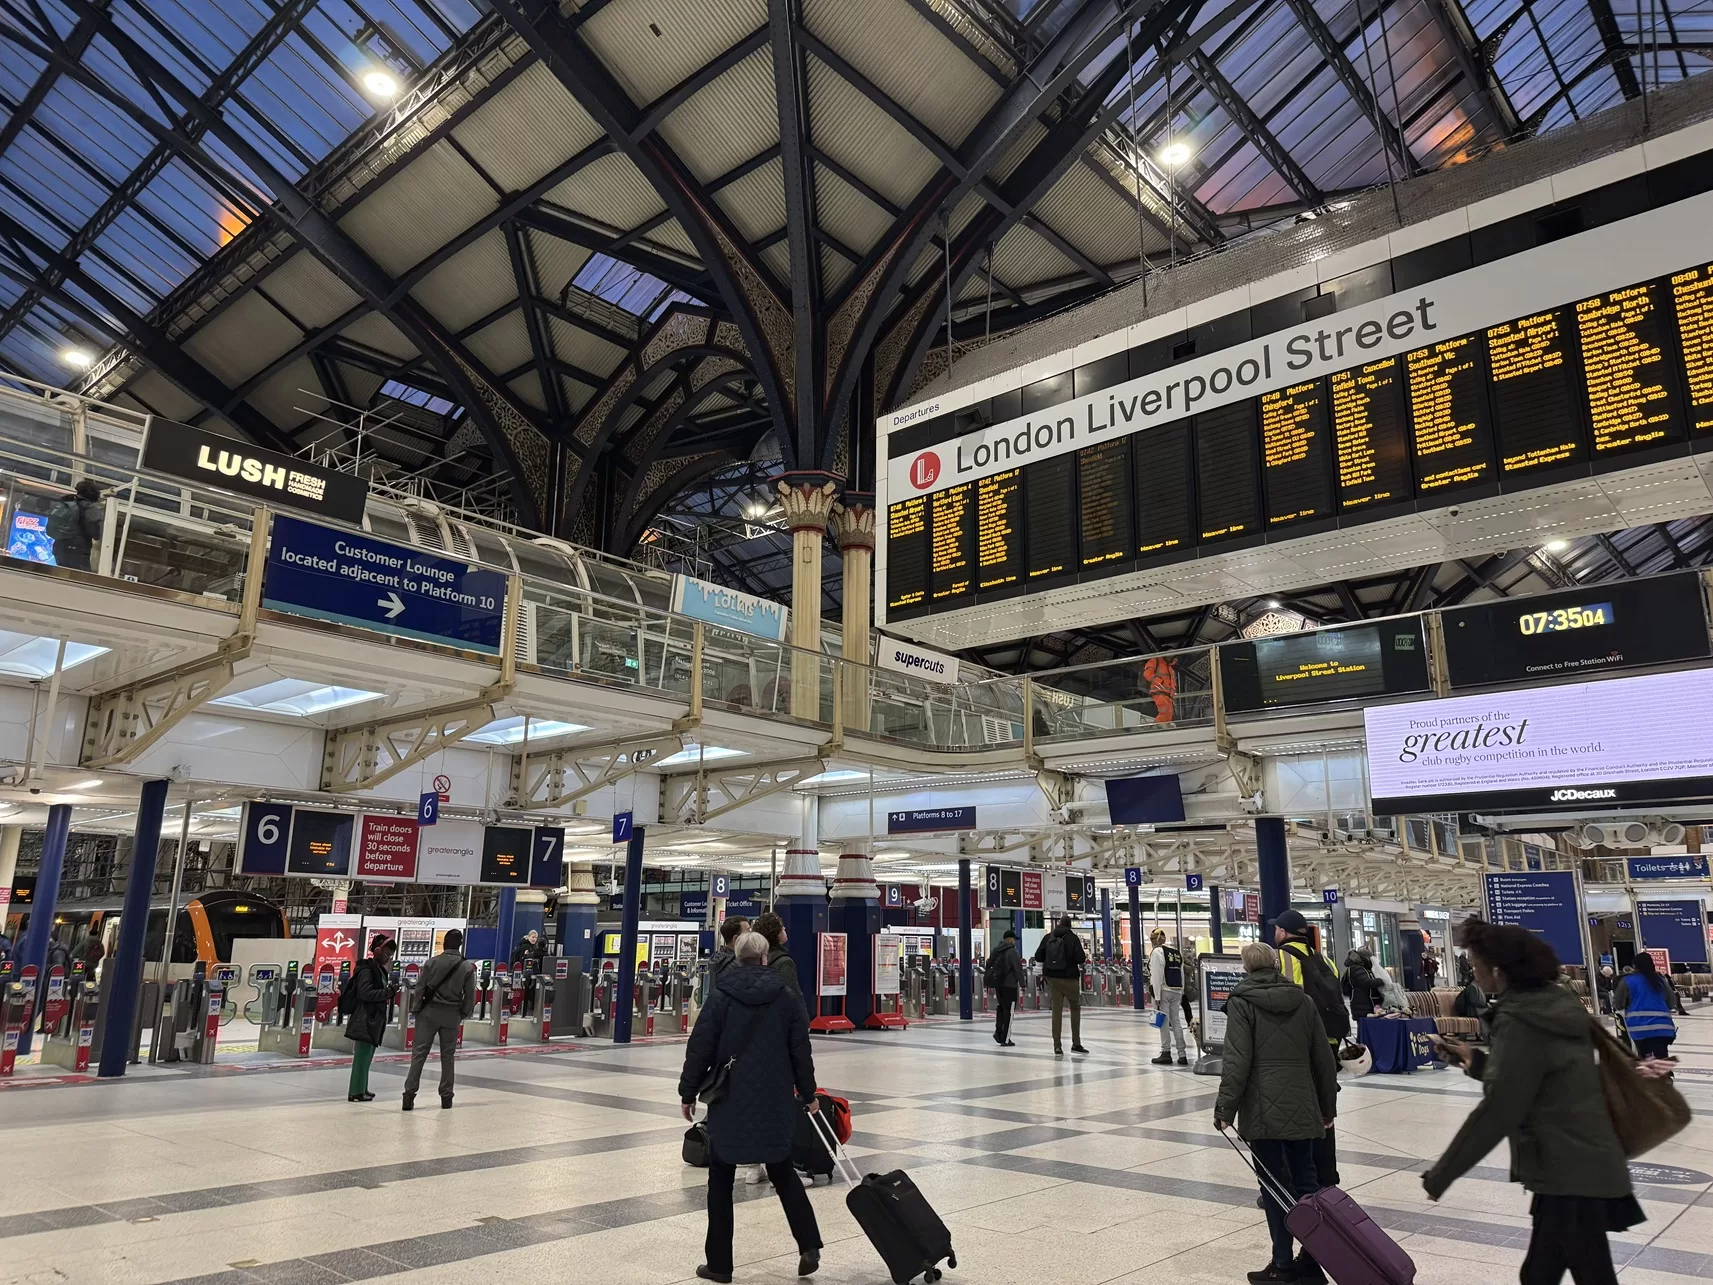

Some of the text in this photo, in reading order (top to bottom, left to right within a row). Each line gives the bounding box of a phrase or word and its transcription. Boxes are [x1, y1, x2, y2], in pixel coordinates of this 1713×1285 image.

[1671, 270, 1698, 284] 08:00
[1576, 286, 1646, 312] 07:58 Platform
[1577, 296, 1649, 322] Cambridge North
[1487, 314, 1552, 337] 07:55 Platform
[1488, 321, 1557, 347] Stansted Airport
[1407, 338, 1467, 361] 07:53 Platform
[1408, 351, 1455, 370] Southend Vic
[1332, 358, 1394, 382] 07:51 Cancelled
[956, 296, 1437, 474] London Liverpool Street
[1286, 383, 1313, 395] Platform
[1332, 375, 1374, 392] Enfield Town
[1262, 397, 1292, 412] Chingford
[894, 404, 940, 426] Departures
[1596, 431, 1664, 450] Greater Anglia
[1503, 454, 1525, 464] beyond
[1504, 452, 1570, 470] Stansted Express
[198, 445, 286, 490] LUSH
[1435, 467, 1471, 478] contactless
[289, 470, 326, 489] FRESH
[994, 472, 1012, 481] Platform
[1421, 472, 1478, 489] Greater Anglia
[287, 486, 323, 501] COSMETICS
[288, 480, 324, 495] HANDMADE
[949, 486, 967, 494] Platform
[334, 541, 455, 583] Customer Lounge
[281, 547, 495, 610] located adjacent to Platform 10
[895, 651, 944, 674] supercuts
[1300, 663, 1327, 671] Welcome
[1526, 662, 1554, 672] Connect
[1580, 658, 1606, 666] Station
[1606, 654, 1624, 663] WiFi
[1276, 664, 1365, 681] Liverpool Street Station
[1410, 710, 1510, 729] Proud partners of the
[1399, 718, 1530, 763] greatest
[1422, 742, 1605, 766] club rugby competition in the world.
[1550, 789, 1616, 801] JCDecaux
[424, 803, 432, 819] 6
[257, 814, 280, 845] 6
[369, 822, 412, 834] Train doors
[619, 818, 627, 836] 7
[368, 833, 403, 843] will close
[367, 842, 410, 852] 30 seconds
[428, 845, 473, 856] greateranglia
[542, 837, 556, 862] 7
[365, 851, 392, 861] before
[364, 860, 403, 871] departure
[1635, 863, 1666, 872] Toilets
[990, 873, 997, 890] 8
[1130, 871, 1136, 882] 8
[1191, 878, 1198, 888] 9
[716, 877, 725, 893] 8
[1086, 883, 1093, 898] 9
[891, 888, 898, 902] 9
[1226, 895, 1234, 909] 10
[1324, 891, 1336, 901] 10
[1418, 1044, 1429, 1056] Dogs
